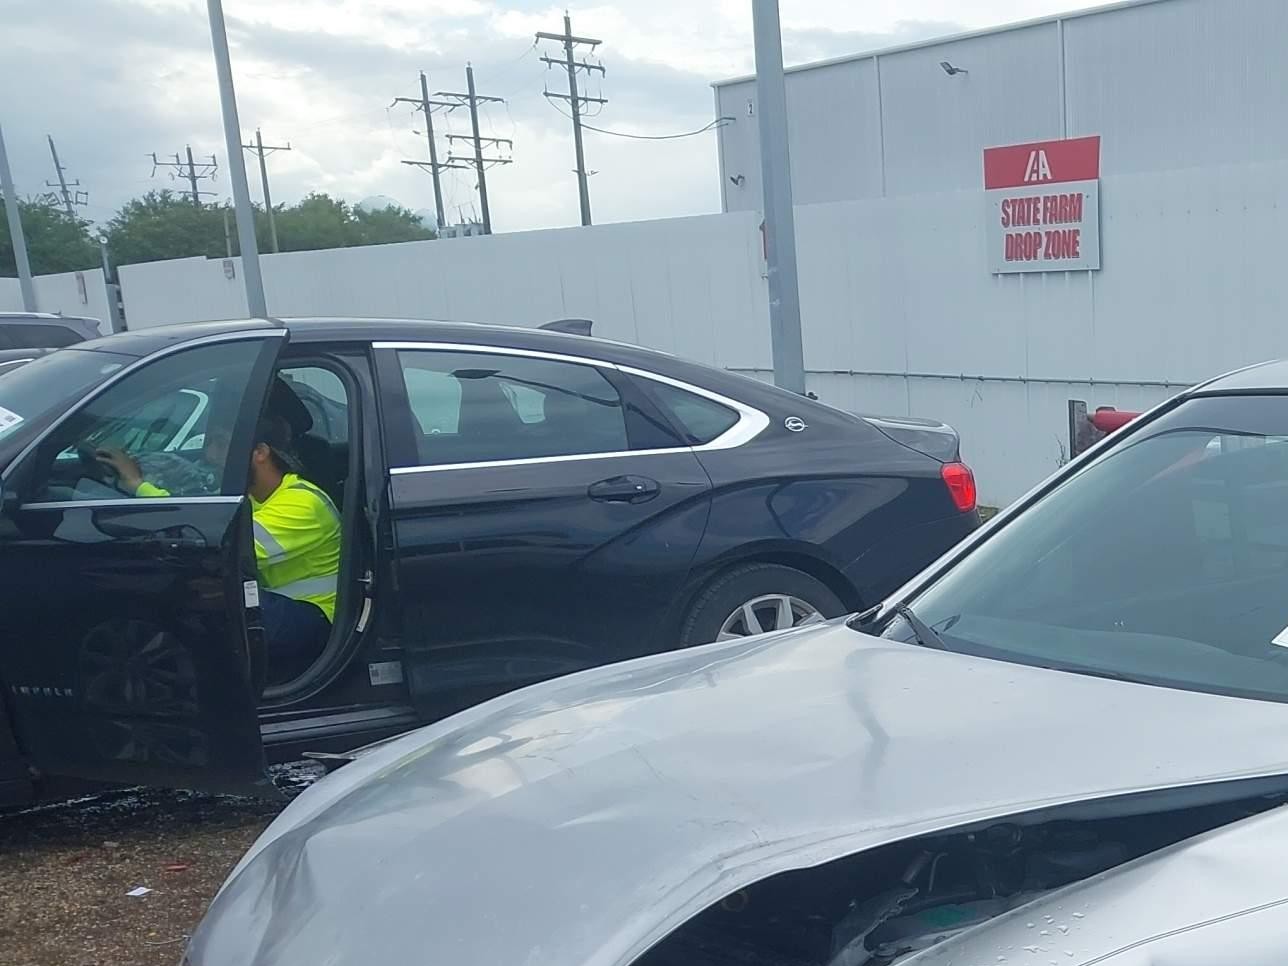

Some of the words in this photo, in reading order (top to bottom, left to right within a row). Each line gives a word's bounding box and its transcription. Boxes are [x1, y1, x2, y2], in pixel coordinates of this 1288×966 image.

[1001, 196, 1041, 228] STATE
[1042, 193, 1083, 225] FARM
[1005, 231, 1042, 262] DROP
[1043, 229, 1081, 260] ZONE
